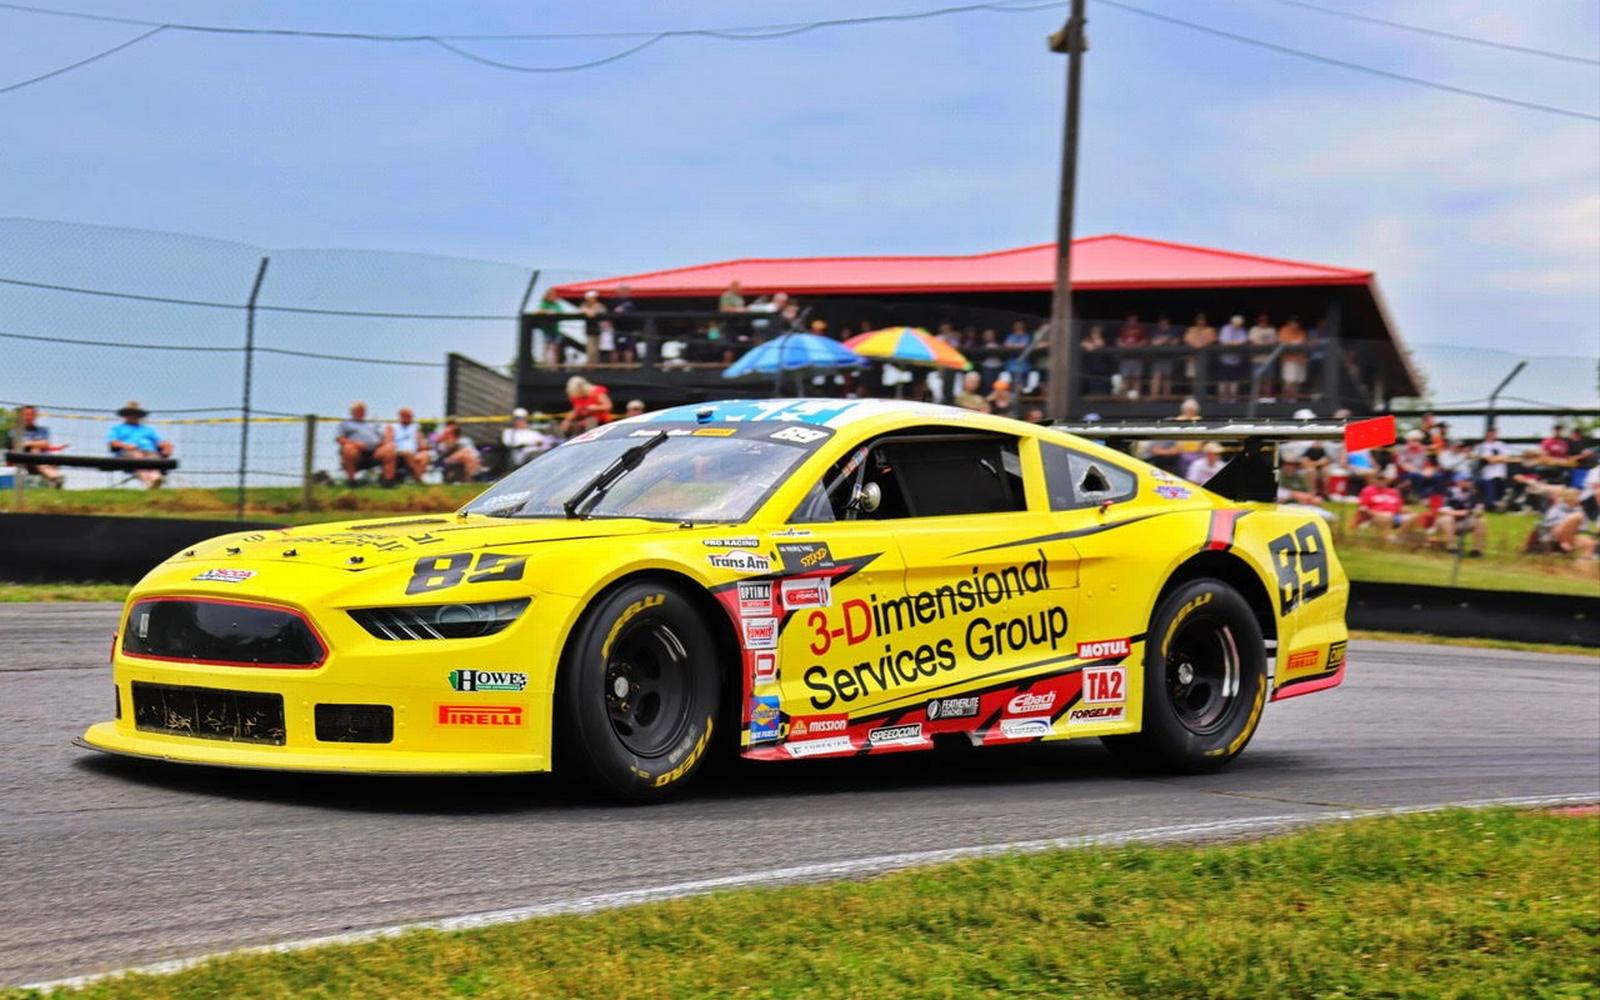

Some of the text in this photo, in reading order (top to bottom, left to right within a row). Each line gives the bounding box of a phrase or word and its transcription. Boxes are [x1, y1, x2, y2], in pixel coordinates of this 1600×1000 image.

[703, 539, 759, 547] PRO RACING
[708, 553, 770, 570] Trans Am
[1268, 521, 1329, 618] 89
[740, 584, 771, 601] OPTIMA
[808, 548, 1050, 656] 3-Dimensional
[803, 605, 1069, 710] Services Group
[1079, 641, 1129, 658] MOTUL
[1288, 650, 1319, 670] PIRELLI
[455, 669, 520, 692] HOWE
[1087, 671, 1123, 700] TA2
[1007, 690, 1057, 714] Eibach
[439, 705, 523, 726] PIRELLI
[1070, 706, 1124, 720] FORGELINE
[809, 719, 848, 732] mission
[871, 725, 921, 741] SPEEDCOM
